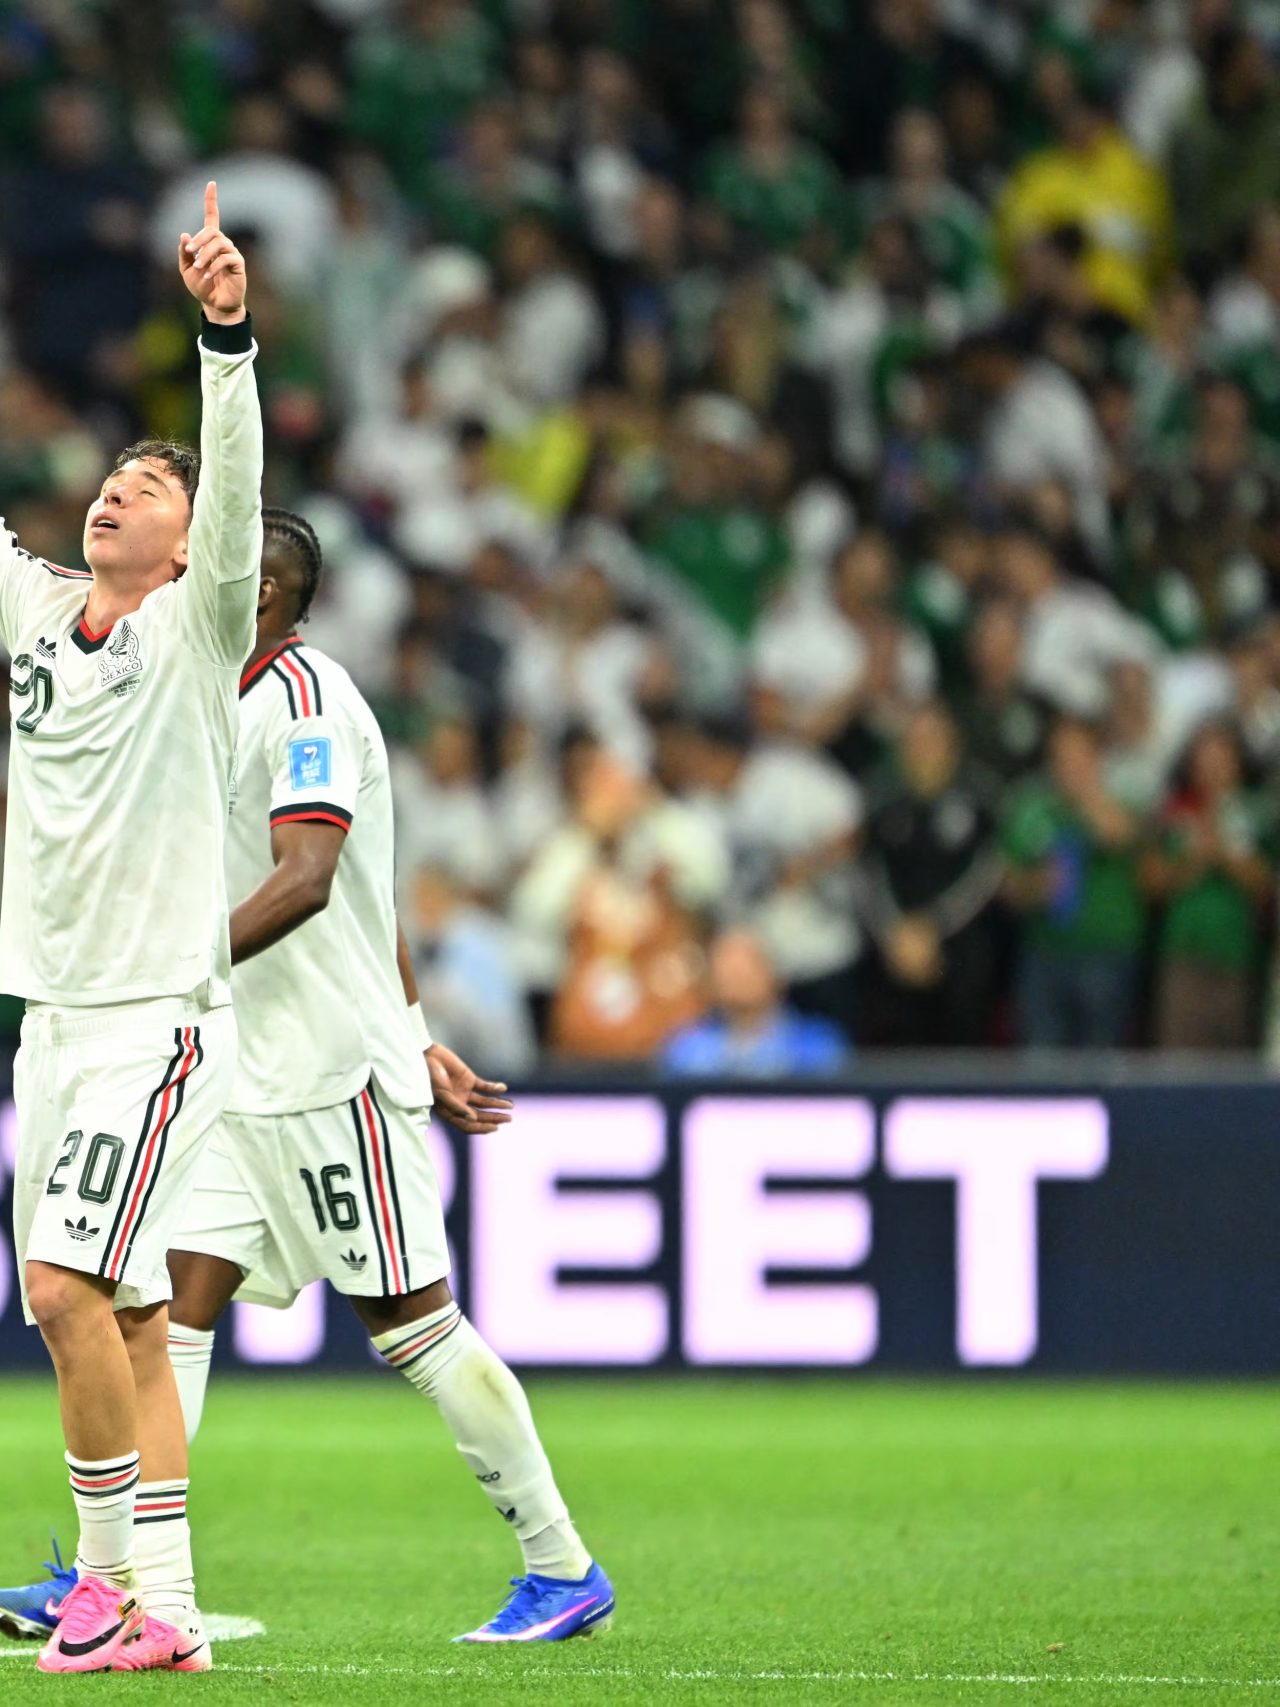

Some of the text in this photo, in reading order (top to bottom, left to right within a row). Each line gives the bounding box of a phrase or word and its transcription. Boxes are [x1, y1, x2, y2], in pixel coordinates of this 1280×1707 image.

[102, 662, 139, 683] MEXICO
[46, 1129, 125, 1206] 20
[299, 1163, 361, 1233] 16
